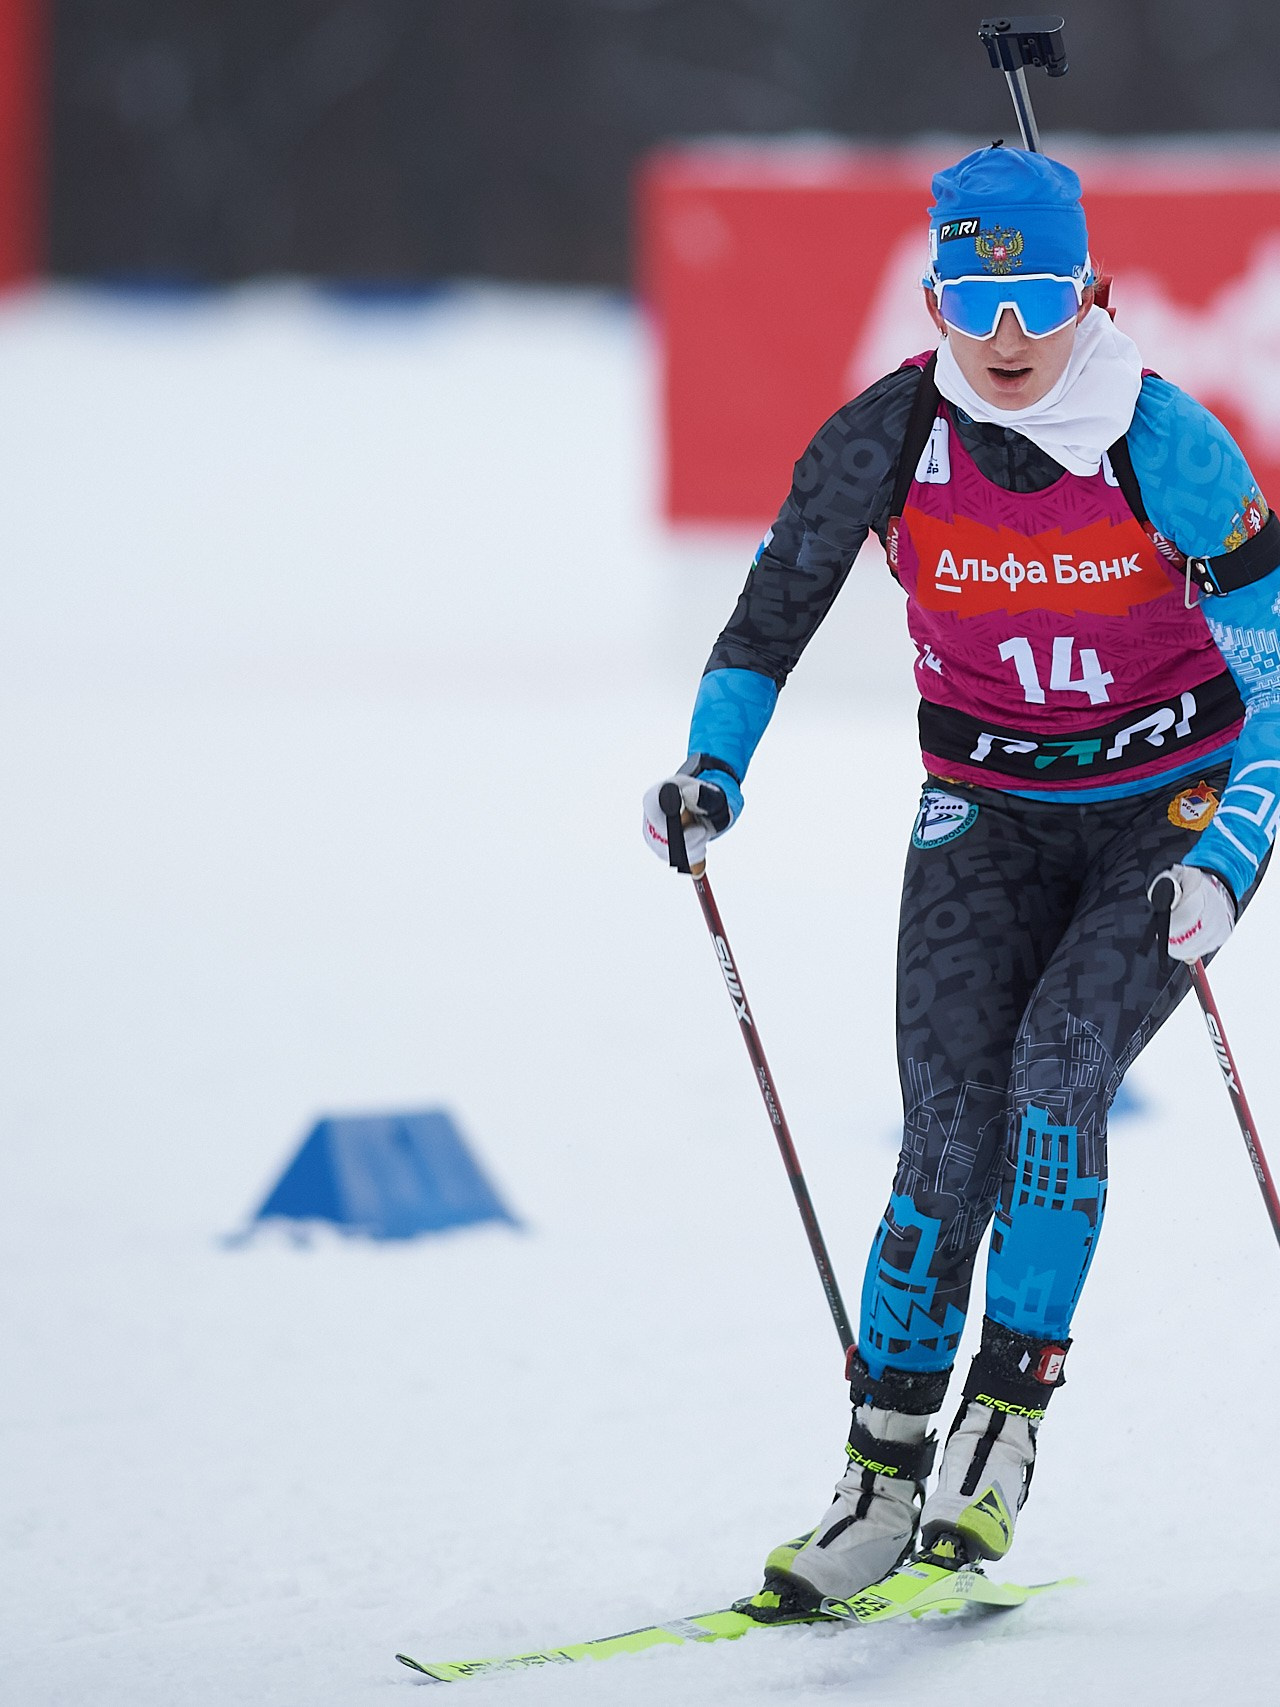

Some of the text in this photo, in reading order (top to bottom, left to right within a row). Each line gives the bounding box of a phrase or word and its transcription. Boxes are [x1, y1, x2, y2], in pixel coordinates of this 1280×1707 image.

[941, 220, 978, 240] PARI
[935, 549, 1142, 592] Альфа Банк
[997, 637, 1114, 705] 14
[969, 692, 1197, 769] PARI
[711, 931, 752, 1026] SWIX
[1205, 1012, 1239, 1096] SWIX
